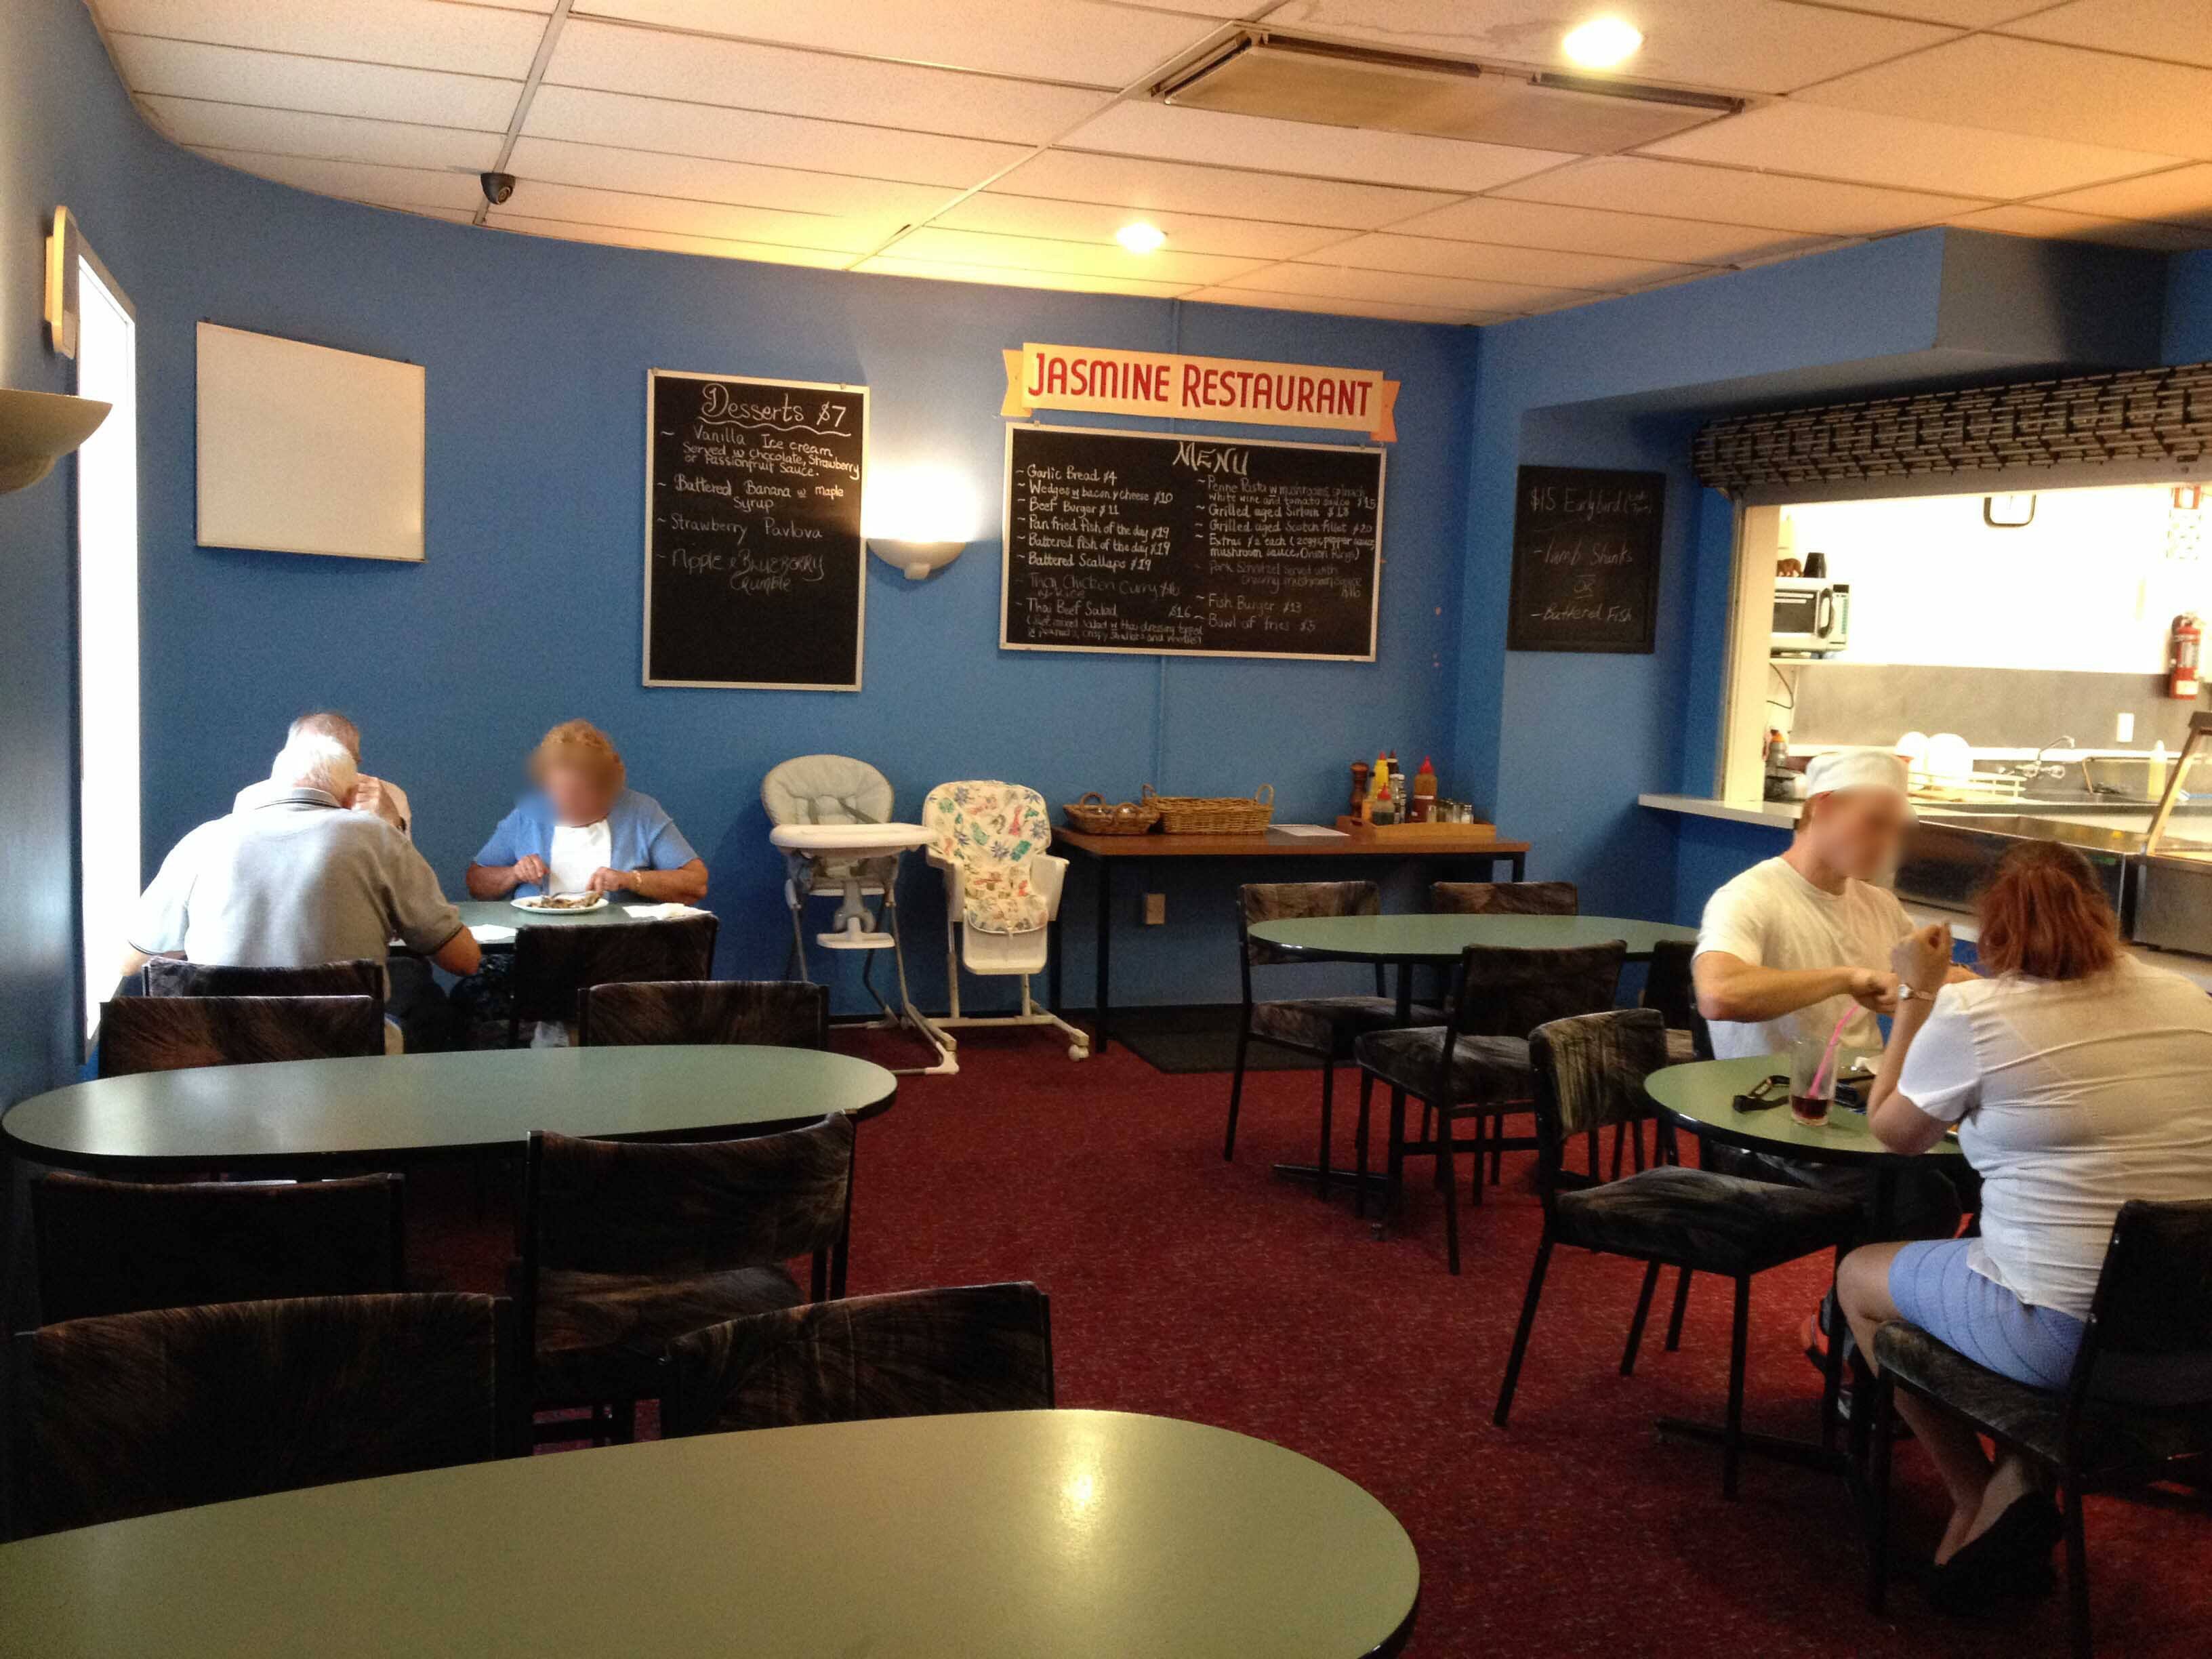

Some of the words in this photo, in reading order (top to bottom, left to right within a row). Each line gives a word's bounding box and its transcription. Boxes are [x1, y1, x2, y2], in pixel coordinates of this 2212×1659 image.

[1028, 352, 1170, 402] JASMINE
[1181, 363, 1373, 417] RESTAURANT
[701, 383, 804, 422] Desserts
[817, 401, 846, 427] $7
[693, 424, 745, 445] Vanilla
[761, 434, 783, 449] Ice
[790, 441, 833, 457] cream
[682, 442, 726, 456] Served
[808, 453, 860, 480] Strawberry
[684, 454, 697, 464] or
[674, 474, 732, 496] Battered
[745, 480, 791, 498] Banana
[1027, 464, 1062, 480] Garlic
[1067, 466, 1100, 481] Bread
[1103, 471, 1117, 486] $4
[1208, 476, 1237, 493] Penne
[1241, 478, 1267, 493] Pasta
[1029, 479, 1070, 501] Wedges
[1082, 488, 1111, 499] bacon
[1120, 488, 1149, 501] cheese
[1154, 492, 1173, 506] $10
[1263, 495, 1280, 505] and
[1284, 496, 1320, 506] tomato
[1530, 487, 1556, 511] $15
[733, 497, 774, 512] Syrup
[1029, 497, 1057, 512] Beef
[1063, 500, 1097, 519] Burger
[1208, 504, 1250, 518] Grilled
[1254, 506, 1282, 523] aged
[671, 513, 747, 544] Strawberry
[764, 517, 823, 539] Pavlova
[1029, 514, 1049, 530] Pan
[1052, 516, 1078, 531] fried
[1103, 521, 1115, 535] of
[1118, 524, 1131, 536] the
[1132, 526, 1149, 542] day
[1151, 527, 1170, 539] $19
[1209, 518, 1252, 532] Grilled
[1255, 521, 1282, 537] aged
[1286, 520, 1319, 532] Scotch
[1029, 532, 1073, 548] Battered
[1100, 539, 1111, 552] of
[1113, 540, 1129, 552] the
[1131, 541, 1148, 558] day
[1150, 542, 1170, 556] $19
[1209, 533, 1242, 546] Extras
[1265, 535, 1287, 546] each
[1028, 551, 1075, 567] Battered
[1130, 558, 1151, 571] $19
[1120, 580, 1158, 597] Curry
[1026, 597, 1051, 613] Thai
[1057, 599, 1082, 615] Beef
[1084, 600, 1118, 617] Salad
[1168, 605, 1191, 618] $16
[1208, 593, 1233, 609] Fish
[1237, 595, 1275, 616] Burger
[1208, 613, 1236, 630] Bowl
[1242, 615, 1257, 629] of
